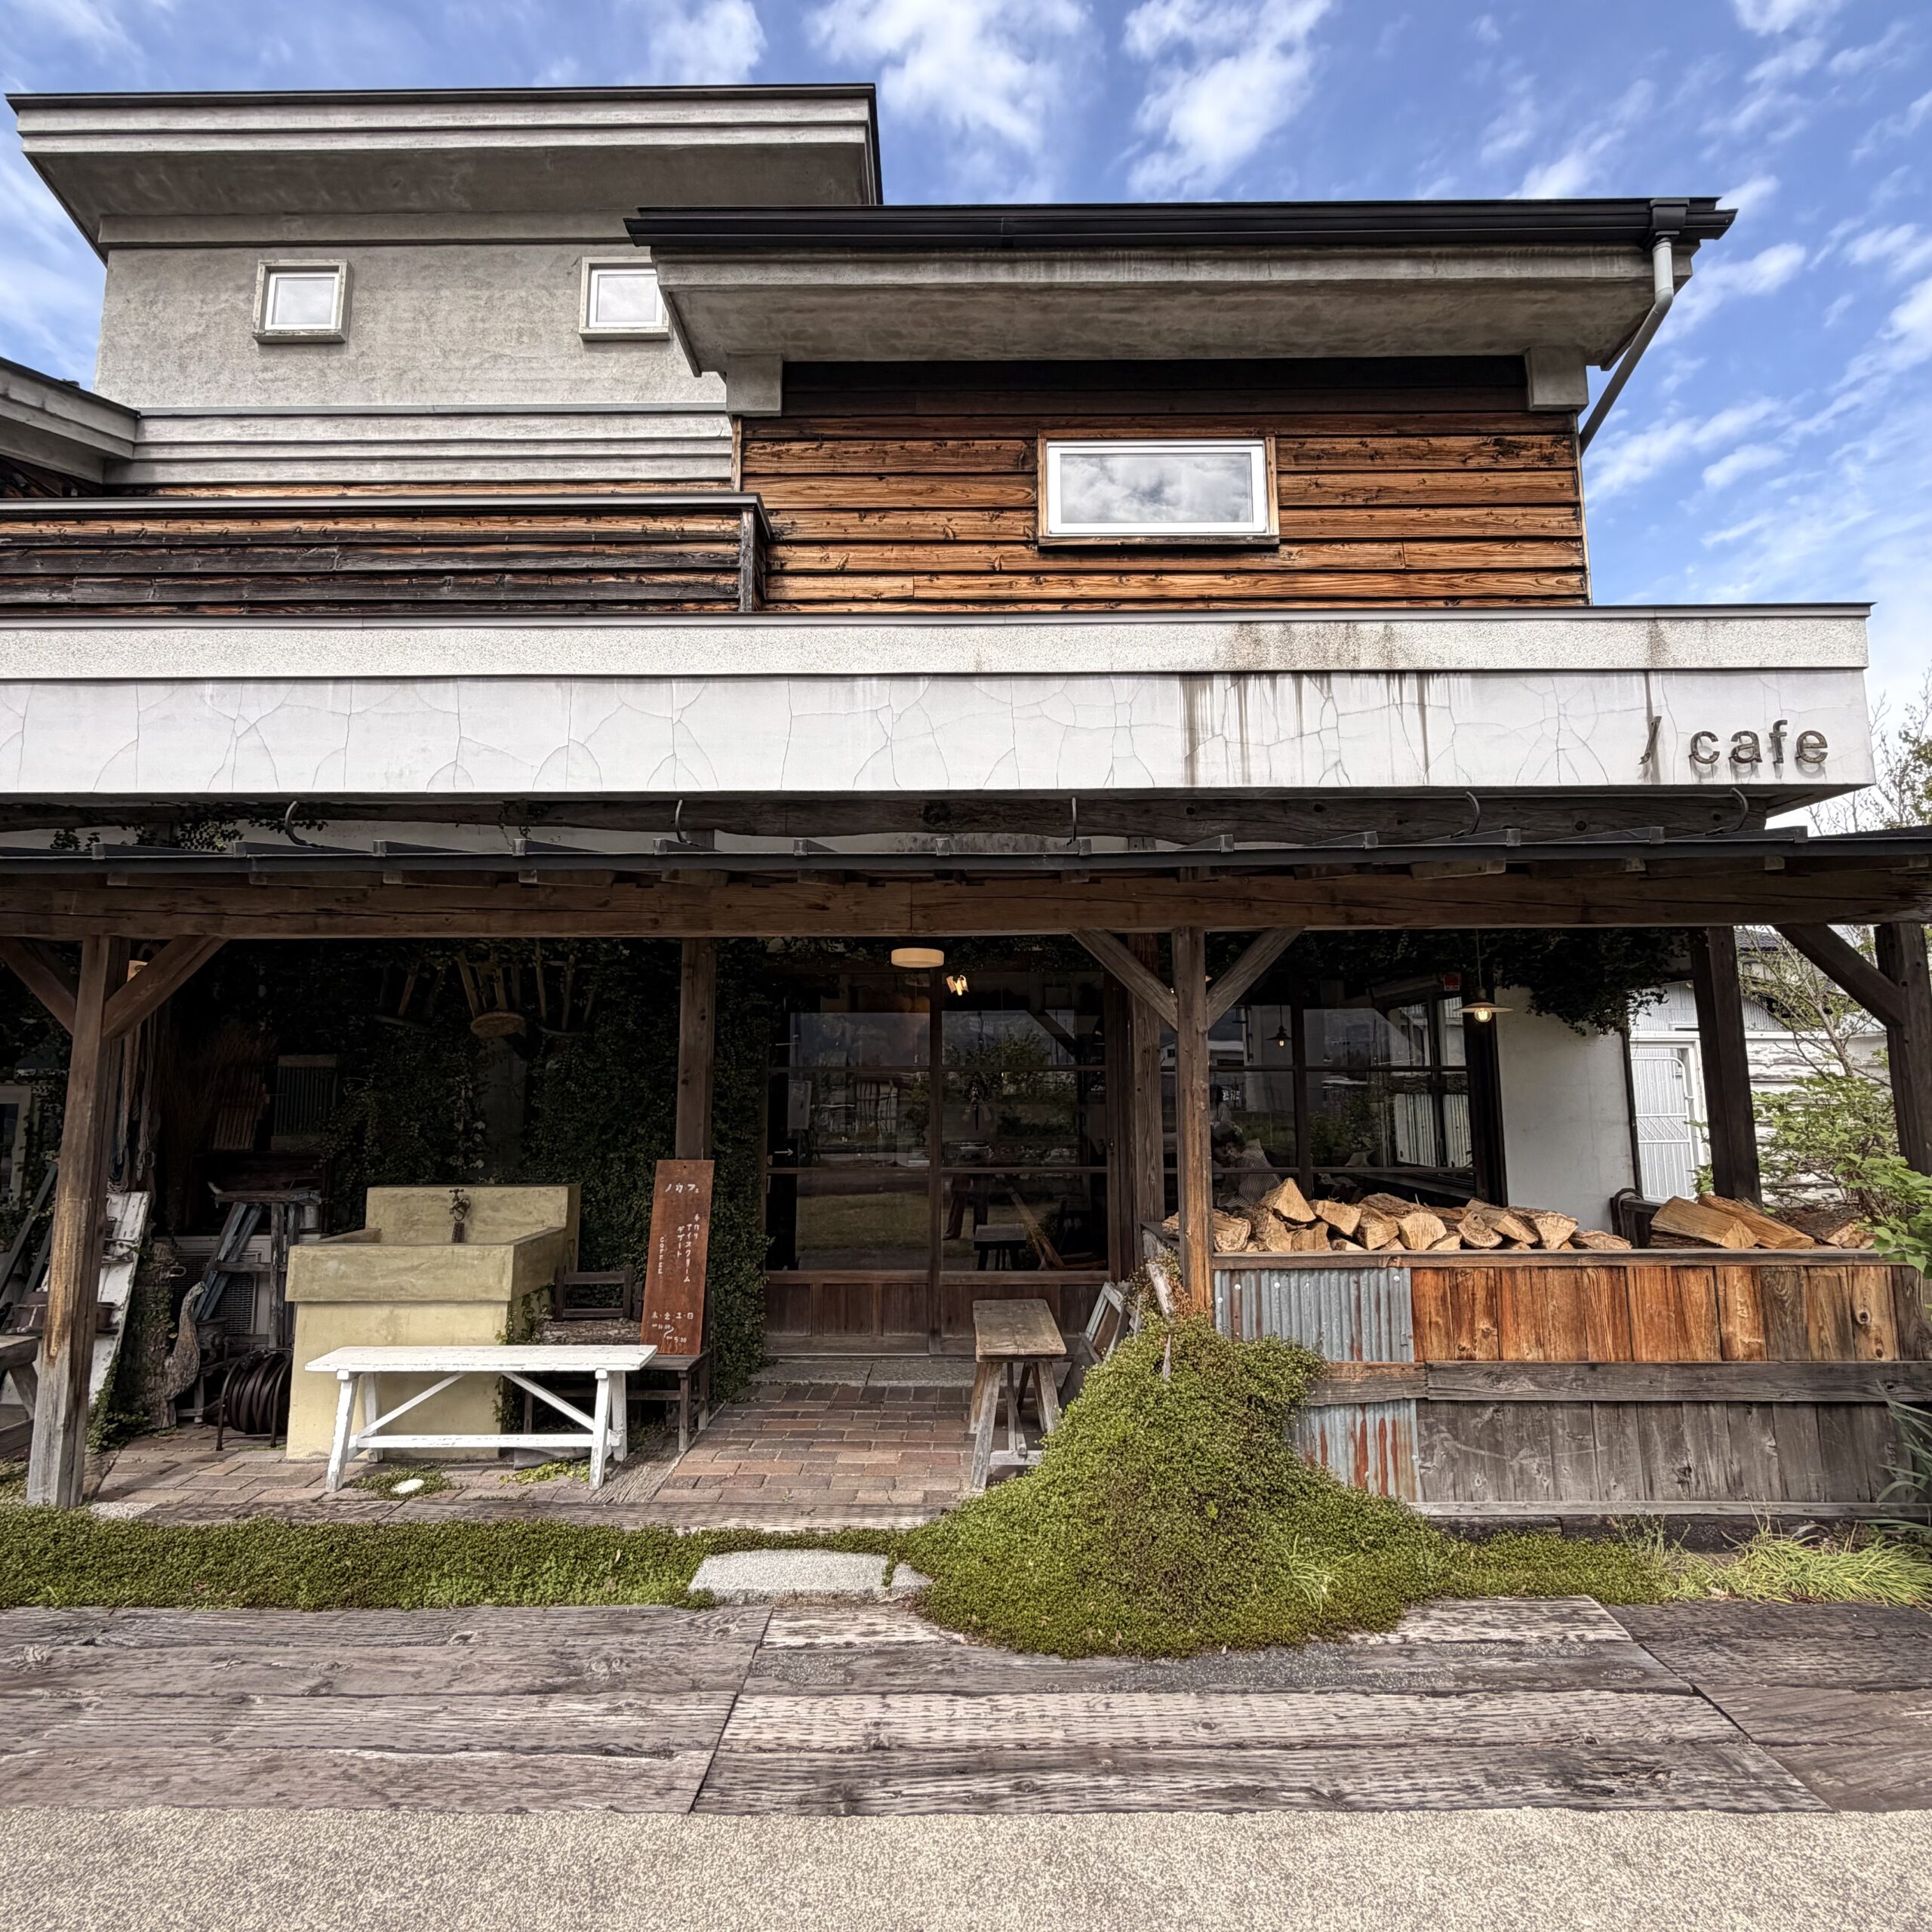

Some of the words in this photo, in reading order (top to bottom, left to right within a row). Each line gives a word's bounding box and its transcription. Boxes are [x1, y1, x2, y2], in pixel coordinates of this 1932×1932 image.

[1690, 719, 1828, 764] cafe
[683, 1223, 692, 1282] アイスクリーム
